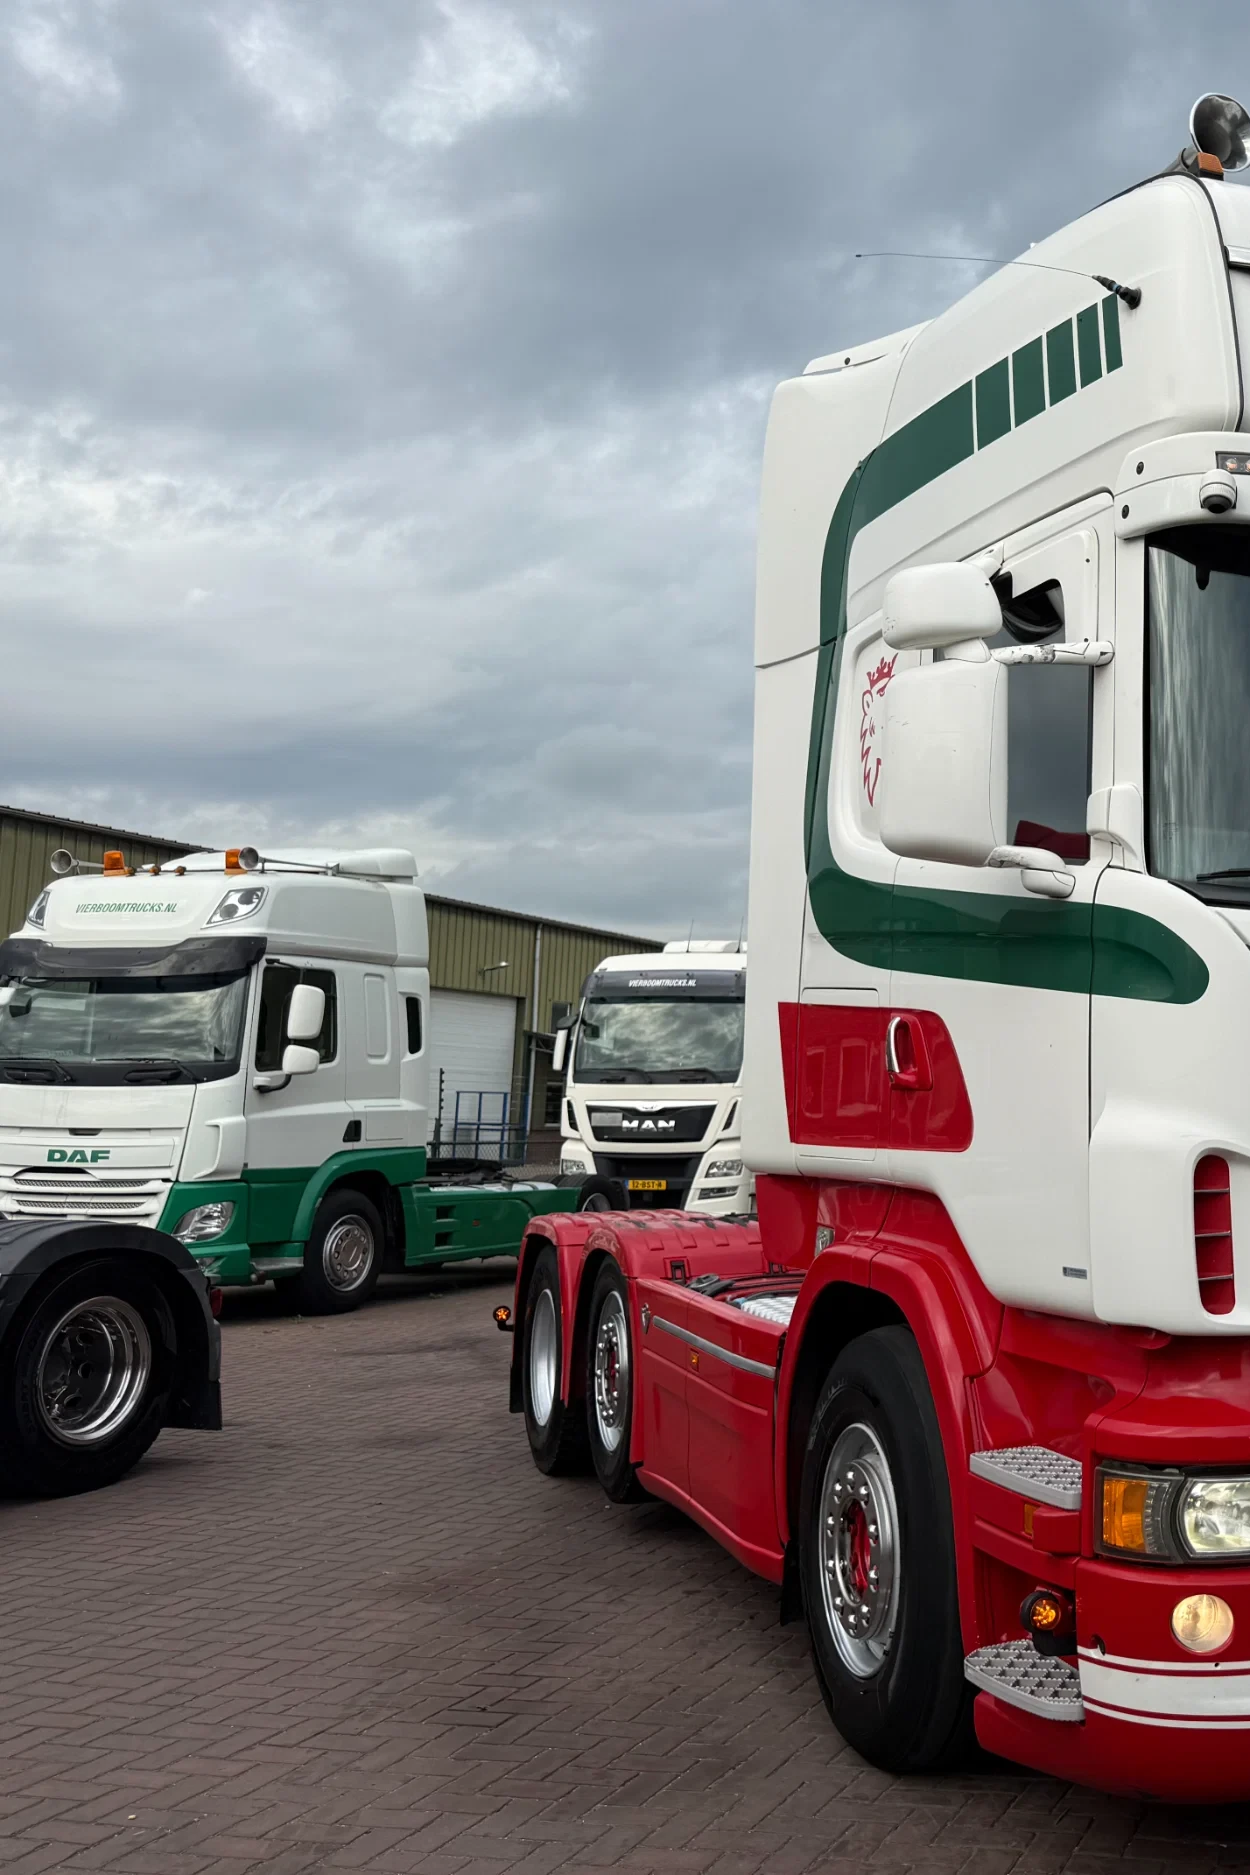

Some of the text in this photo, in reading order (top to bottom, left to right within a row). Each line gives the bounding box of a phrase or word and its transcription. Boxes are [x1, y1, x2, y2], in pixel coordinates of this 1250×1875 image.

[76, 903, 178, 913] VIERBOOMTRUCKS.NL
[628, 979, 697, 987] VIERBOOMTRUCKS.NL
[622, 1120, 675, 1132] MAN
[47, 1149, 111, 1163] DAF
